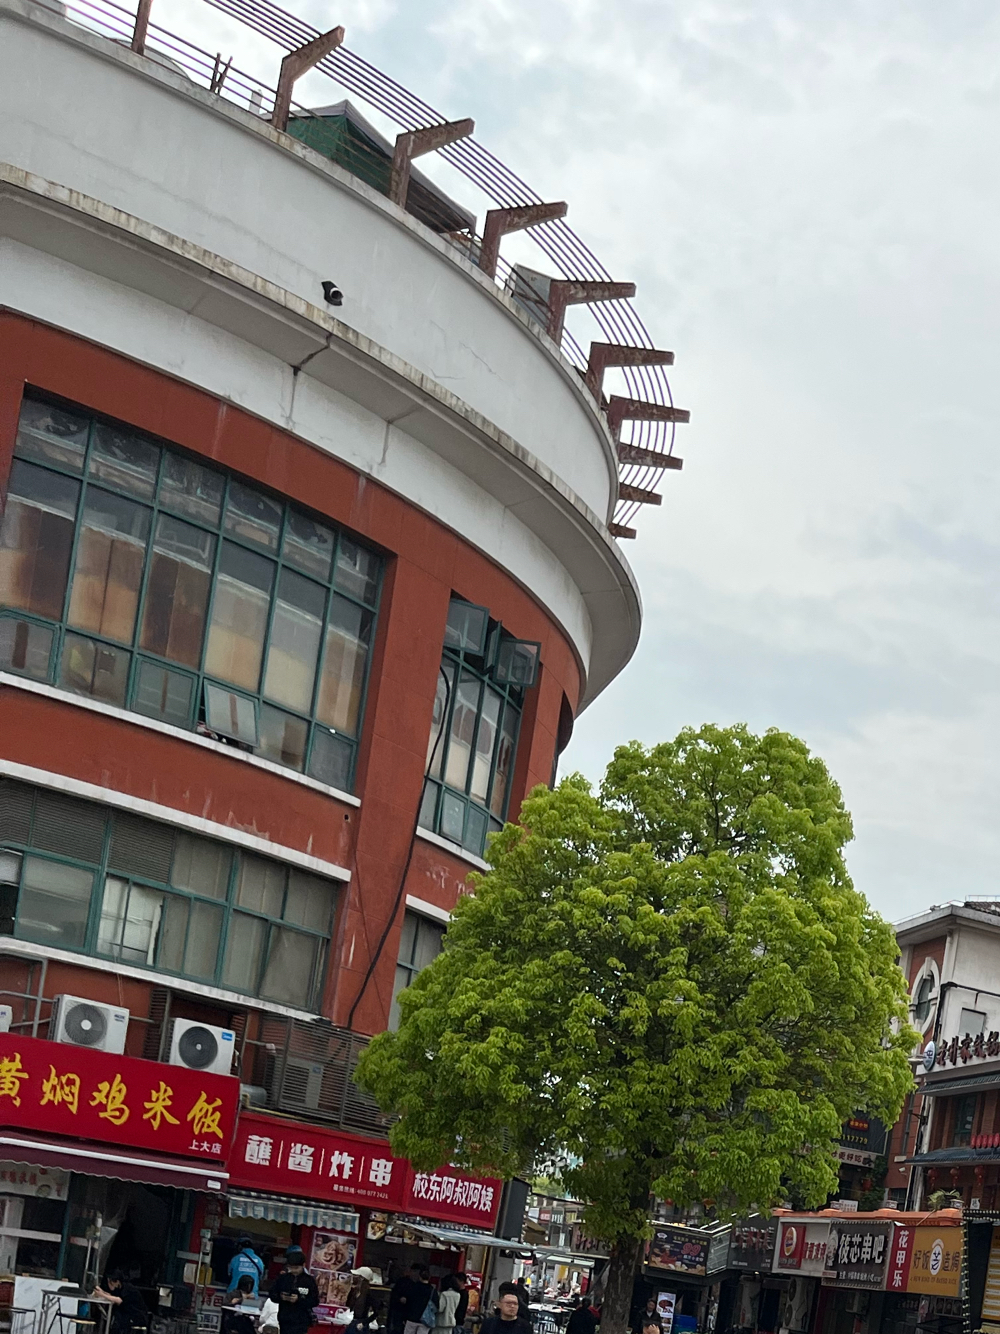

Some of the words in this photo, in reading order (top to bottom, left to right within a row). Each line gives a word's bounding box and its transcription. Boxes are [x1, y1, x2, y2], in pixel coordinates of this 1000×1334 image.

[0, 1052, 224, 1139] 黄焖鸡米饭
[187, 1139, 222, 1154] 上大店
[412, 1173, 494, 1213] 校东阿叔阿姨
[892, 1230, 910, 1288] 花甲乐
